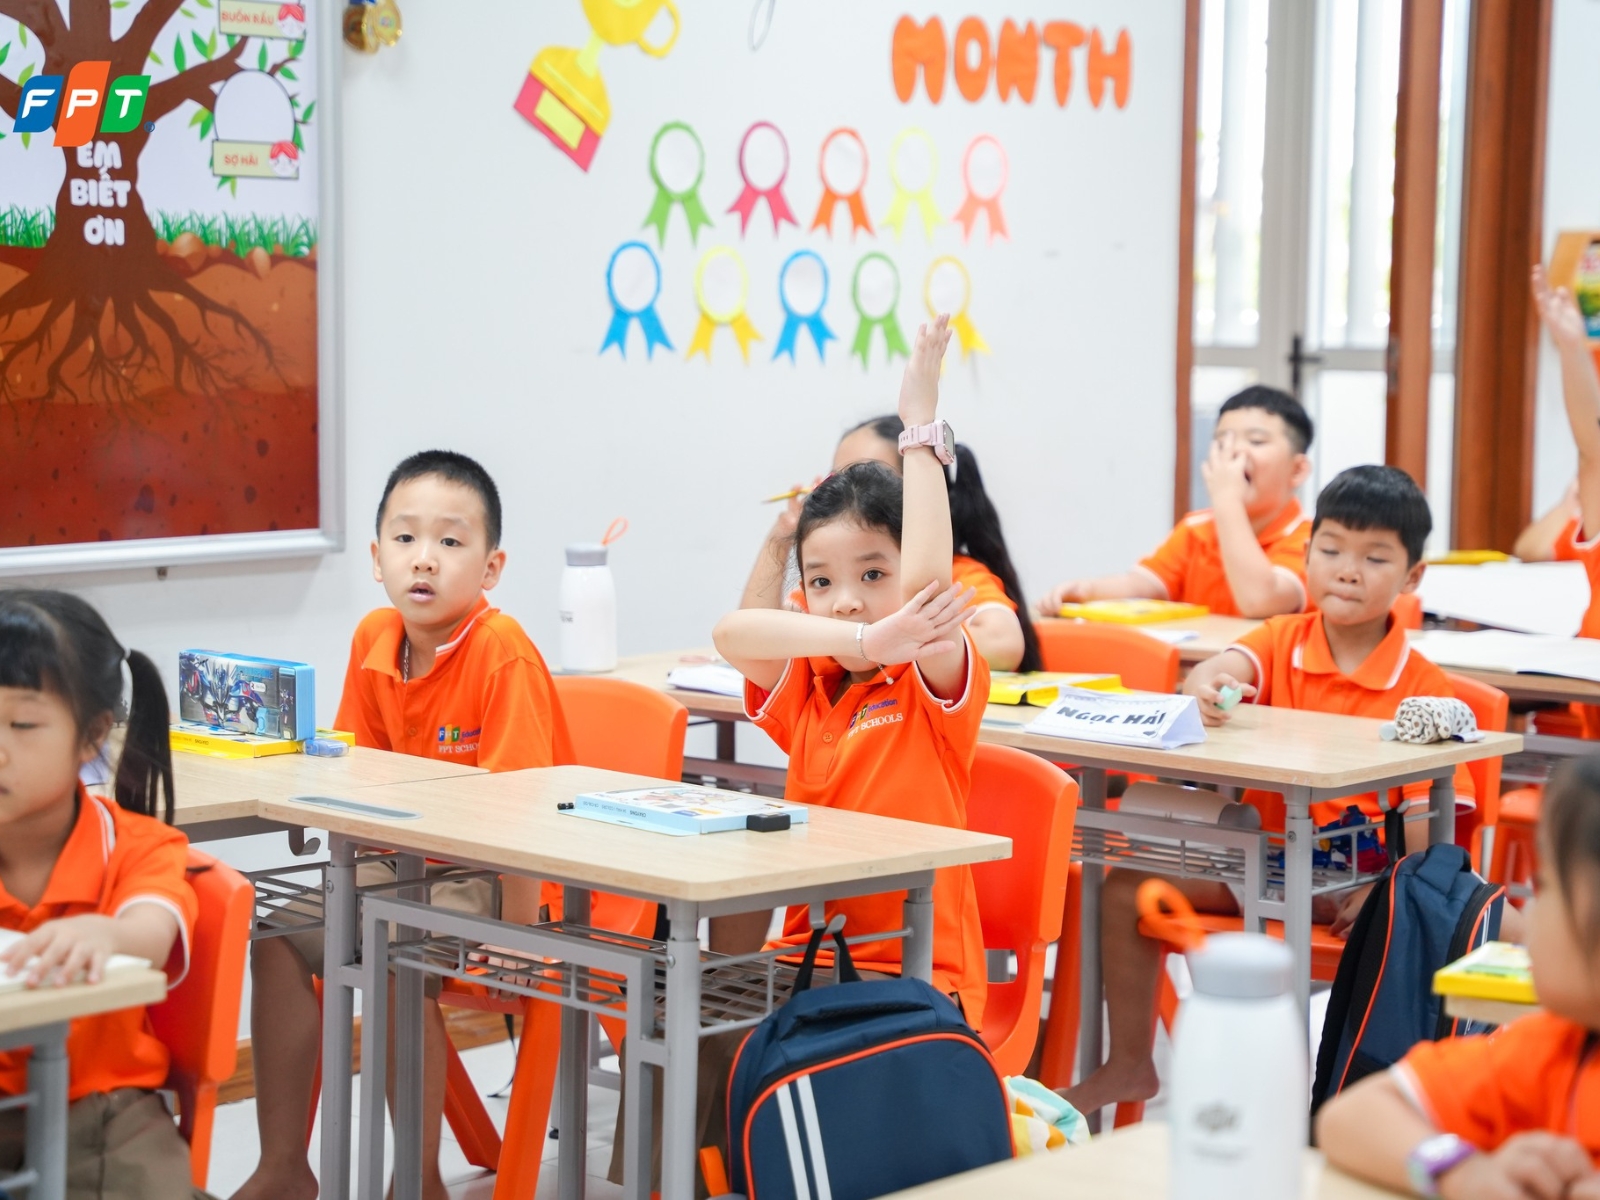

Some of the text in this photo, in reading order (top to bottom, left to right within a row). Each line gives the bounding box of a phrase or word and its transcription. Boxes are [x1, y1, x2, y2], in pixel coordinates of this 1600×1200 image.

[891, 14, 1132, 109] MONTH
[76, 140, 122, 169] EM
[70, 166, 131, 208] BIẾT
[83, 214, 125, 246] ƠN
[861, 712, 904, 730] SCHOOLS
[1056, 706, 1120, 724] NGỌC
[455, 742, 478, 753] SCHO
